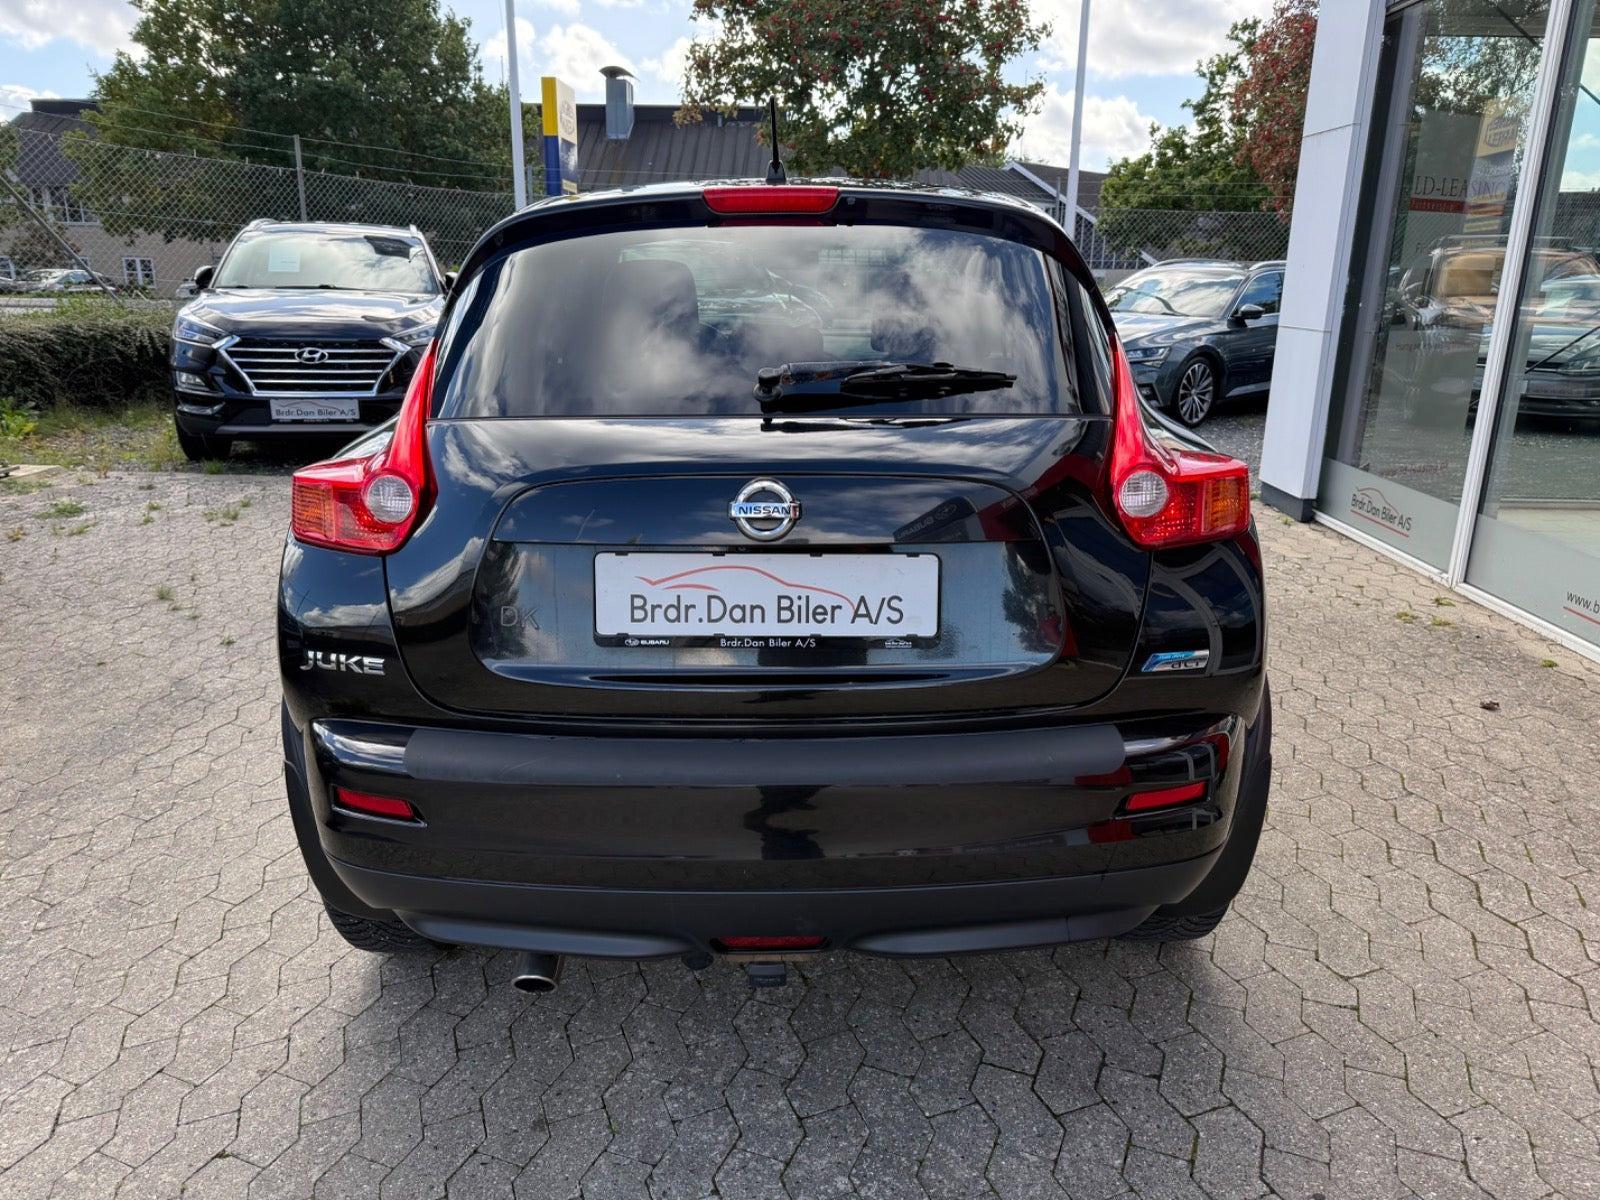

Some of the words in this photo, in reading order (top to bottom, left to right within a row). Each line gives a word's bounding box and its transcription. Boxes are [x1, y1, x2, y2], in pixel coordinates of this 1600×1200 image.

[340, 408, 356, 417] A/S
[738, 505, 791, 515] NISSAN
[1351, 493, 1380, 517] Brdr.Dan
[1381, 506, 1397, 524] Biler
[1397, 514, 1412, 531] A/S
[500, 606, 540, 630] DK
[630, 594, 766, 625] Brdr.Dan
[776, 594, 843, 625] Biler
[850, 594, 905, 626] A/S
[720, 638, 765, 648] Brdr.Dan
[769, 638, 791, 648] Biler
[795, 638, 816, 649] A/S
[300, 650, 386, 676] JUKE
